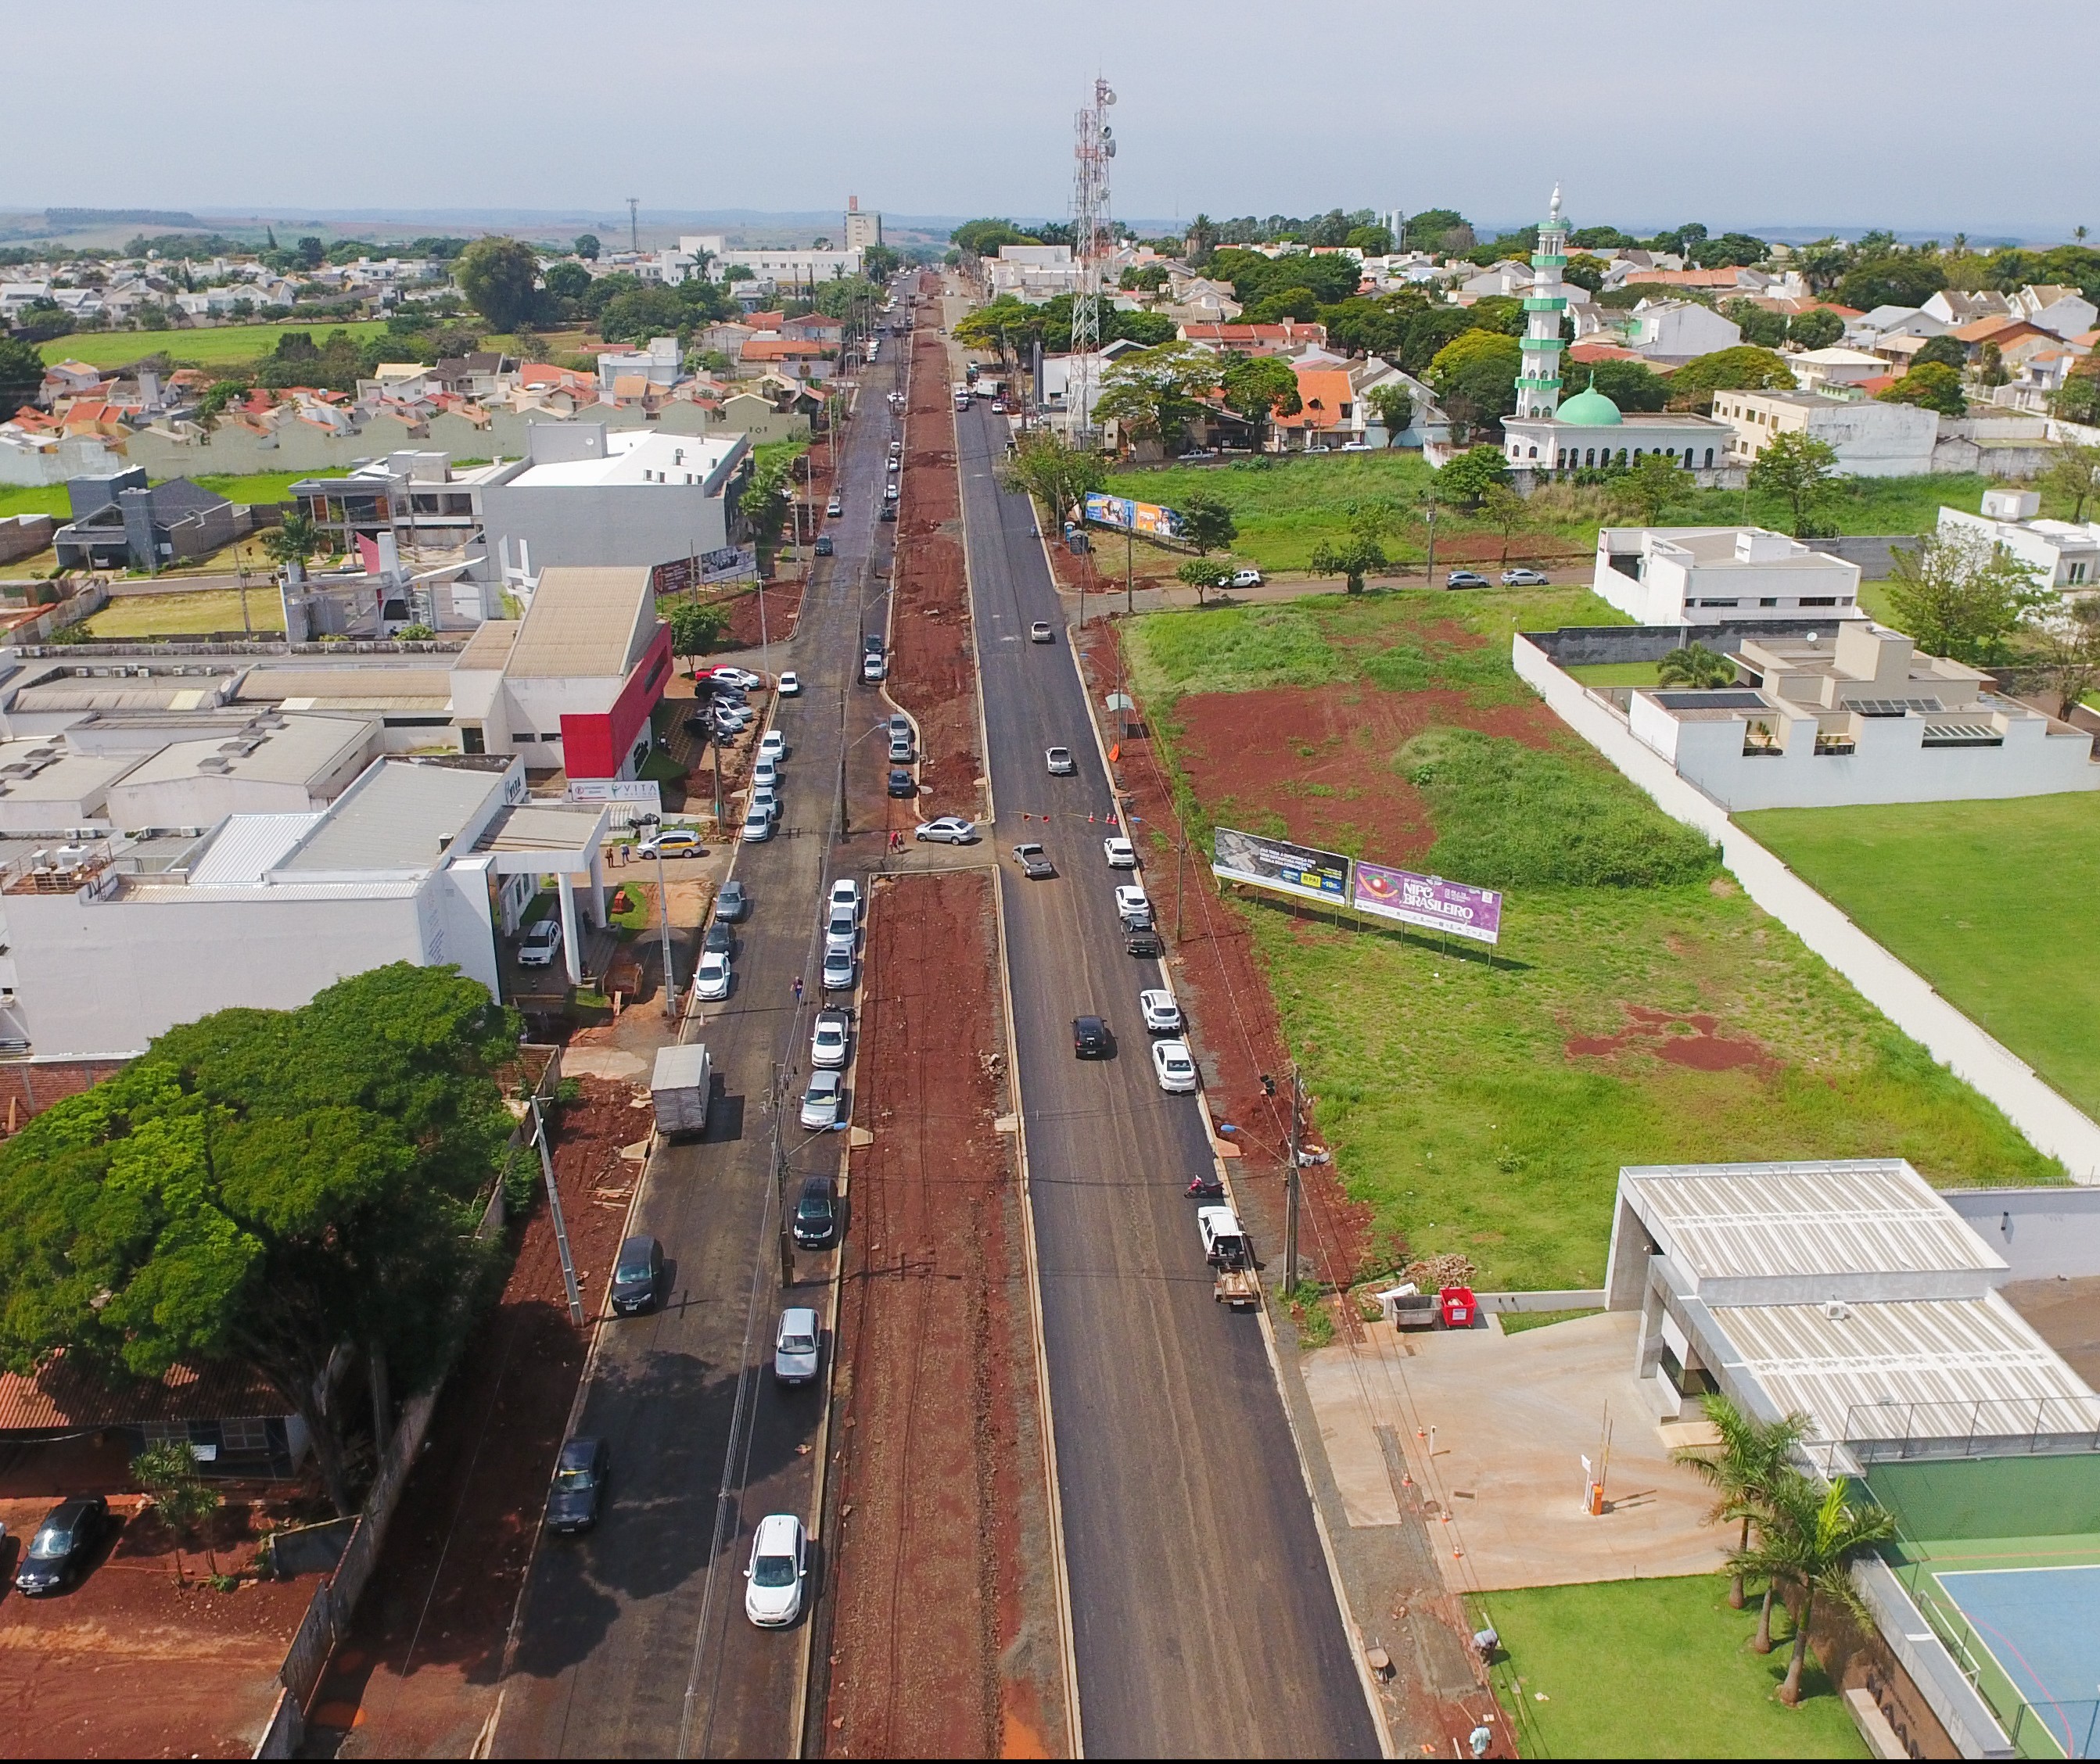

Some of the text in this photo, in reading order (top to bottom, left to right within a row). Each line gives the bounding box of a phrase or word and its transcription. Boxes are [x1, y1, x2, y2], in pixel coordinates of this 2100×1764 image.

[624, 783, 657, 793] VITA
[1402, 882, 1434, 898] NIPO
[1402, 893, 1474, 920] BRASILEIRO
